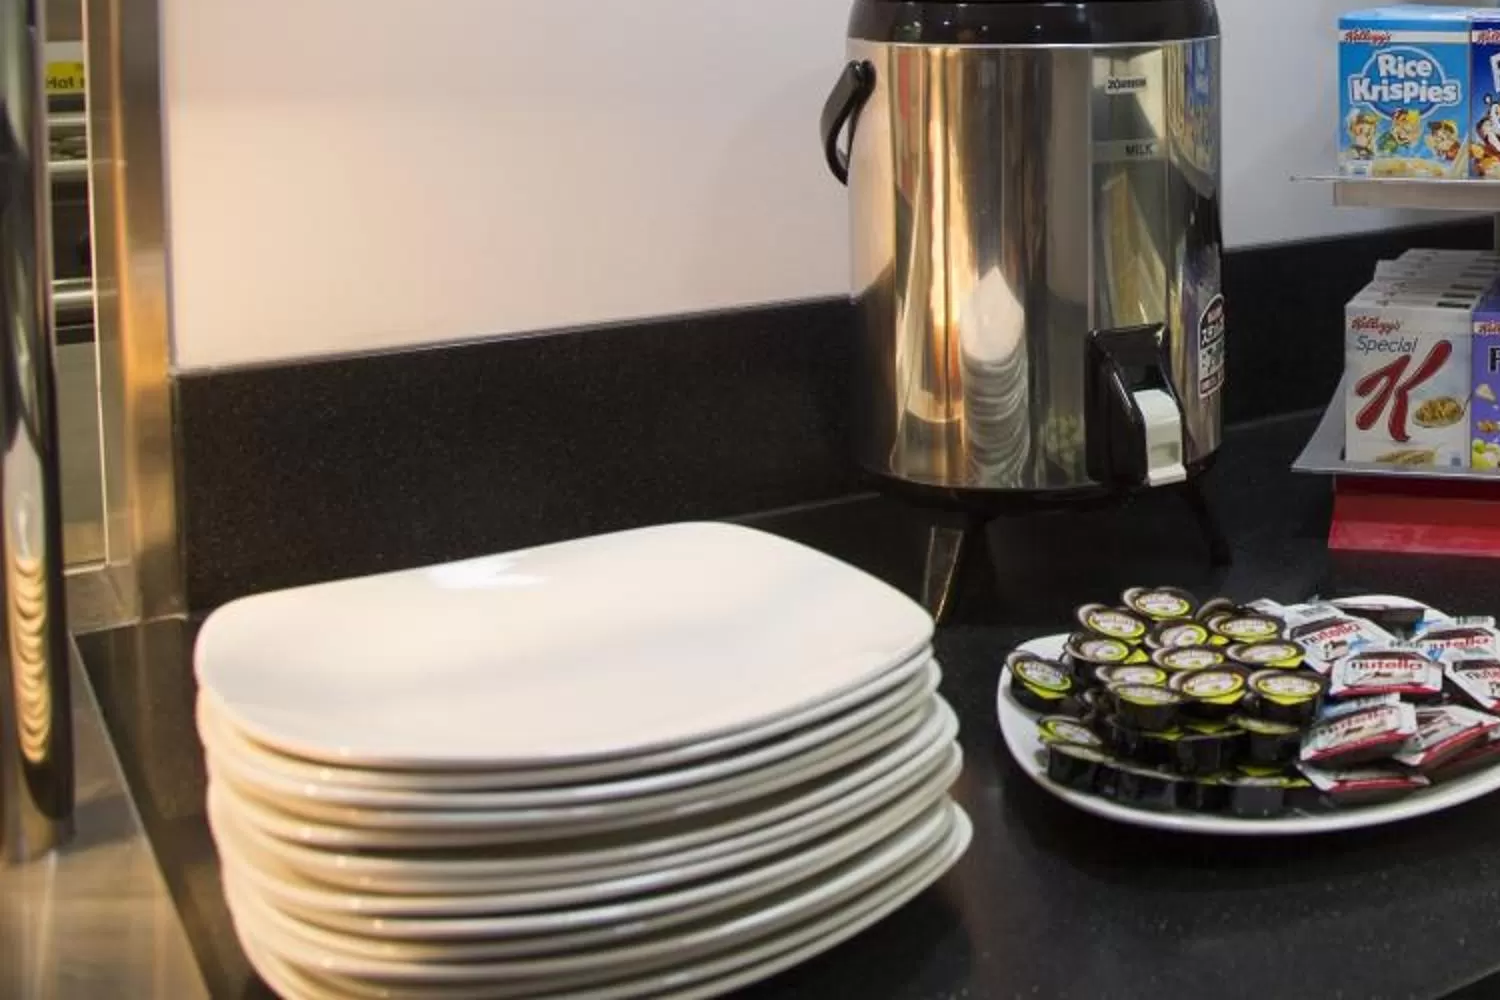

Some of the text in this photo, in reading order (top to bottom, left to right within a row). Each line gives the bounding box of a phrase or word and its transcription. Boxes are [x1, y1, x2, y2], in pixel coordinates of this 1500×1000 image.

[1344, 26, 1391, 45] Kellogg's
[1377, 53, 1433, 78] Rice
[1352, 79, 1459, 103] Krispies
[1351, 315, 1400, 335] Kellogg's
[1356, 335, 1418, 355] Special
[1354, 339, 1452, 442] K
[1302, 622, 1361, 645] nutella
[1351, 657, 1422, 671] nutella
